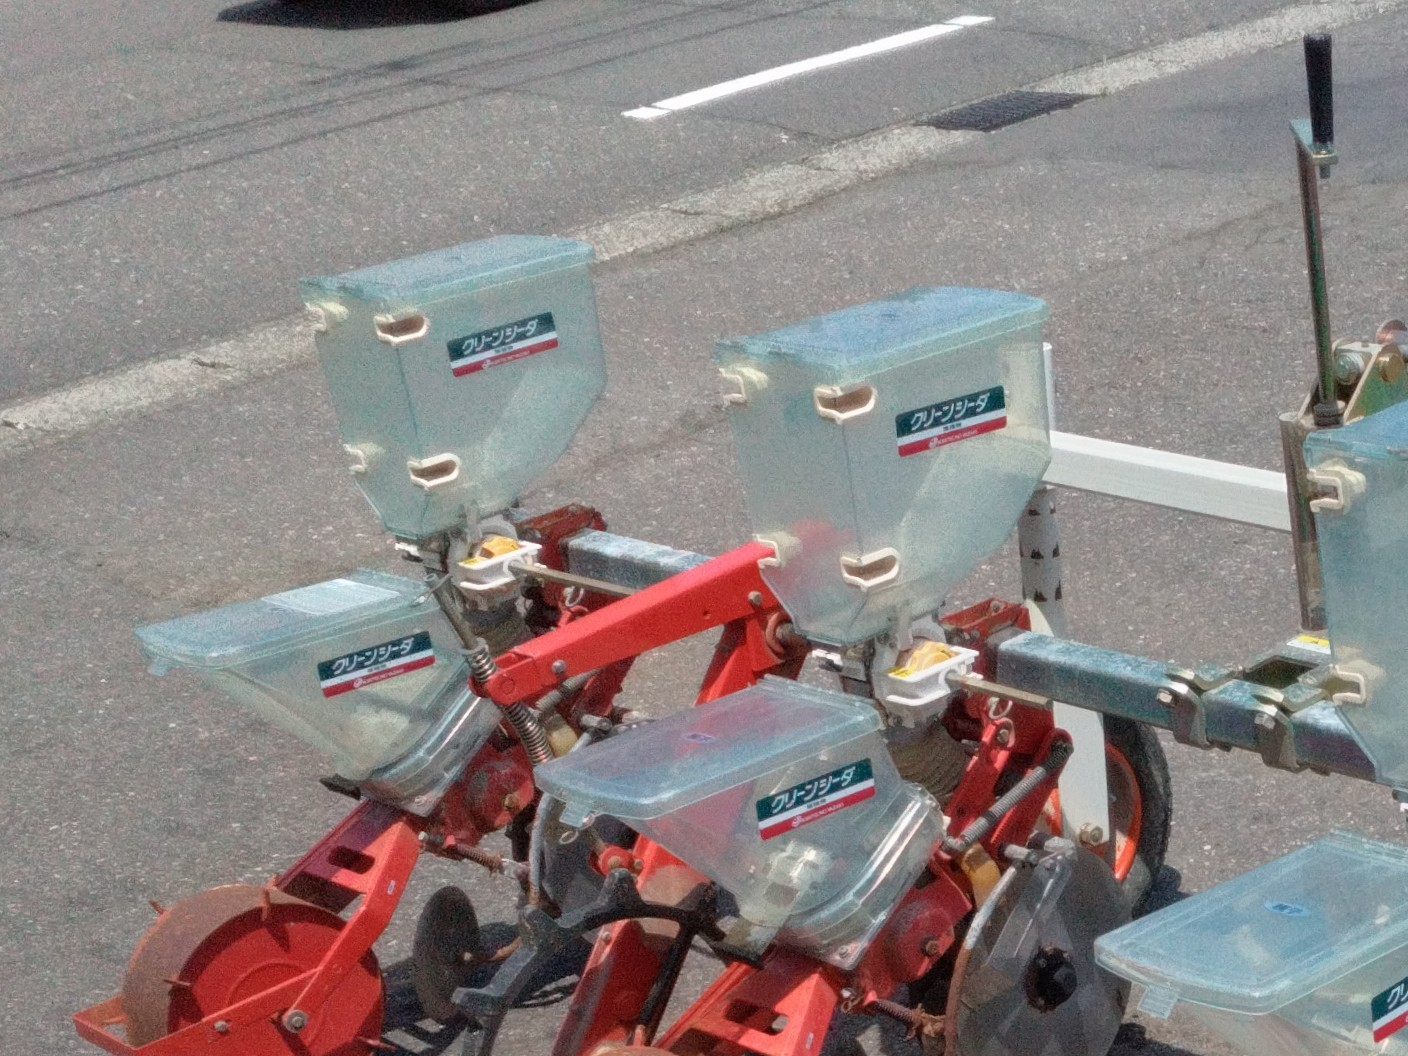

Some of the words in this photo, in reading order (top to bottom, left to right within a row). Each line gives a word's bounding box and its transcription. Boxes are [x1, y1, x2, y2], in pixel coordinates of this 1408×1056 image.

[462, 319, 539, 355] クリーンシーダ
[911, 392, 990, 431] クリーンシーダ
[330, 637, 415, 675] クリーンシーダ
[771, 766, 856, 813] クリーンシーダ
